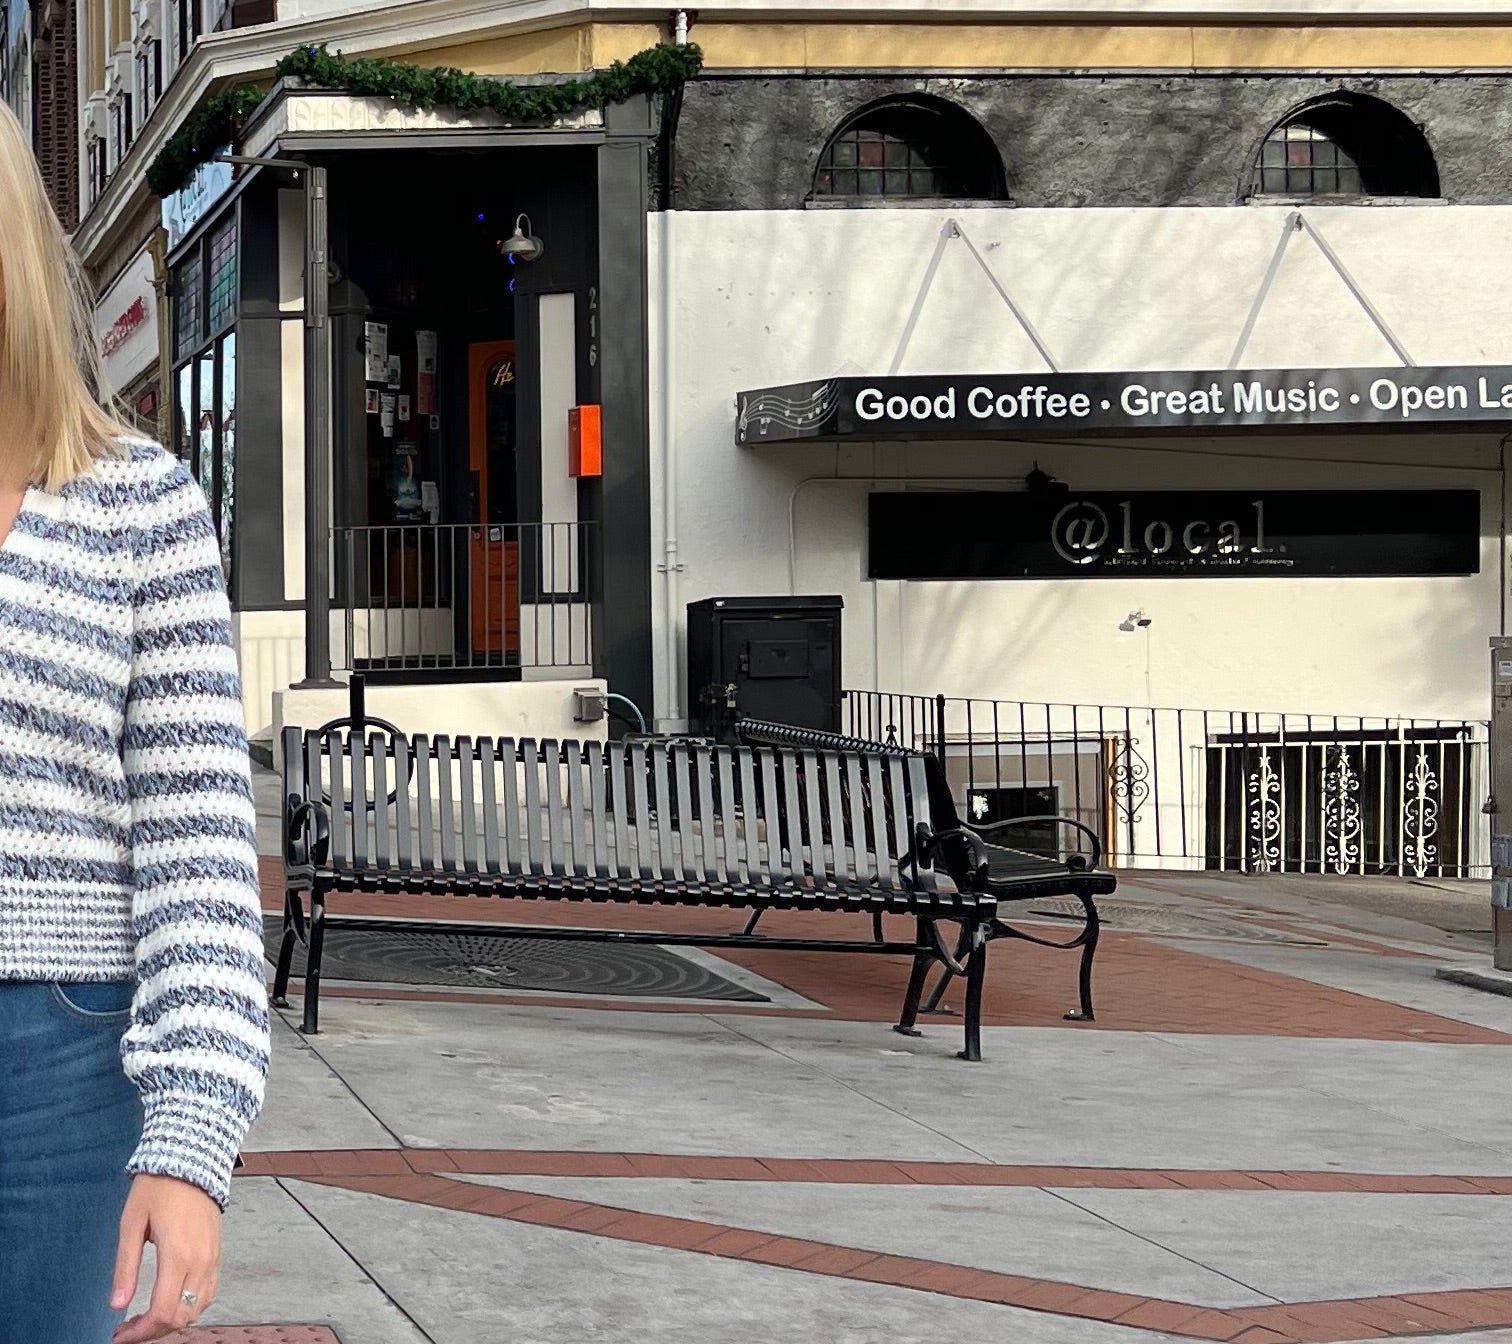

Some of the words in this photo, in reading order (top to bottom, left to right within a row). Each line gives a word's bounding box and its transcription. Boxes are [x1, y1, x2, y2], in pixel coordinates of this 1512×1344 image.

[589, 286, 597, 367] 216
[855, 386, 955, 420] Good
[967, 385, 1090, 418] Coffee
[1120, 383, 1225, 416] Great
[1233, 380, 1341, 414] Music
[1369, 378, 1468, 418] Open
